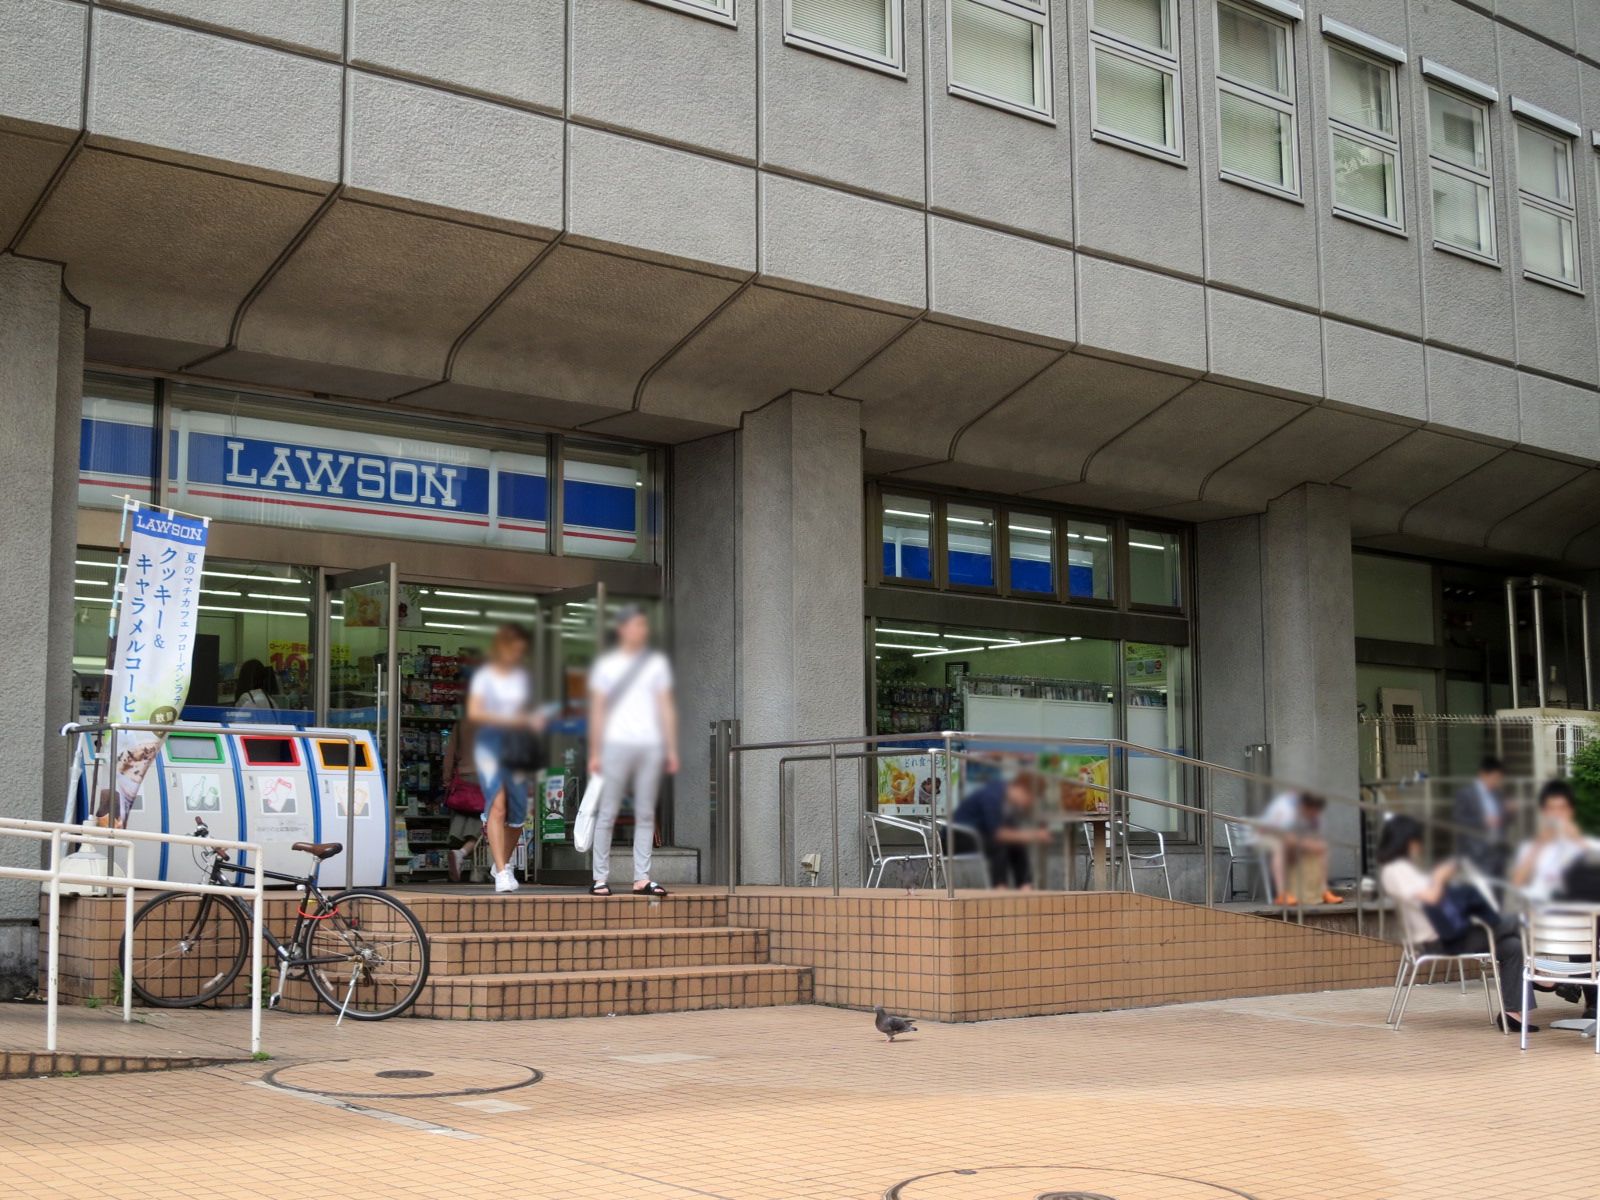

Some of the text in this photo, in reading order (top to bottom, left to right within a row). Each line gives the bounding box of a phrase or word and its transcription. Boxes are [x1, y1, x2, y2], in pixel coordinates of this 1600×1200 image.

[226, 441, 457, 507] LAWSON
[136, 515, 203, 540] LAWSON
[154, 547, 177, 648] クッキー&
[180, 552, 198, 627] 夏のマチカフェ
